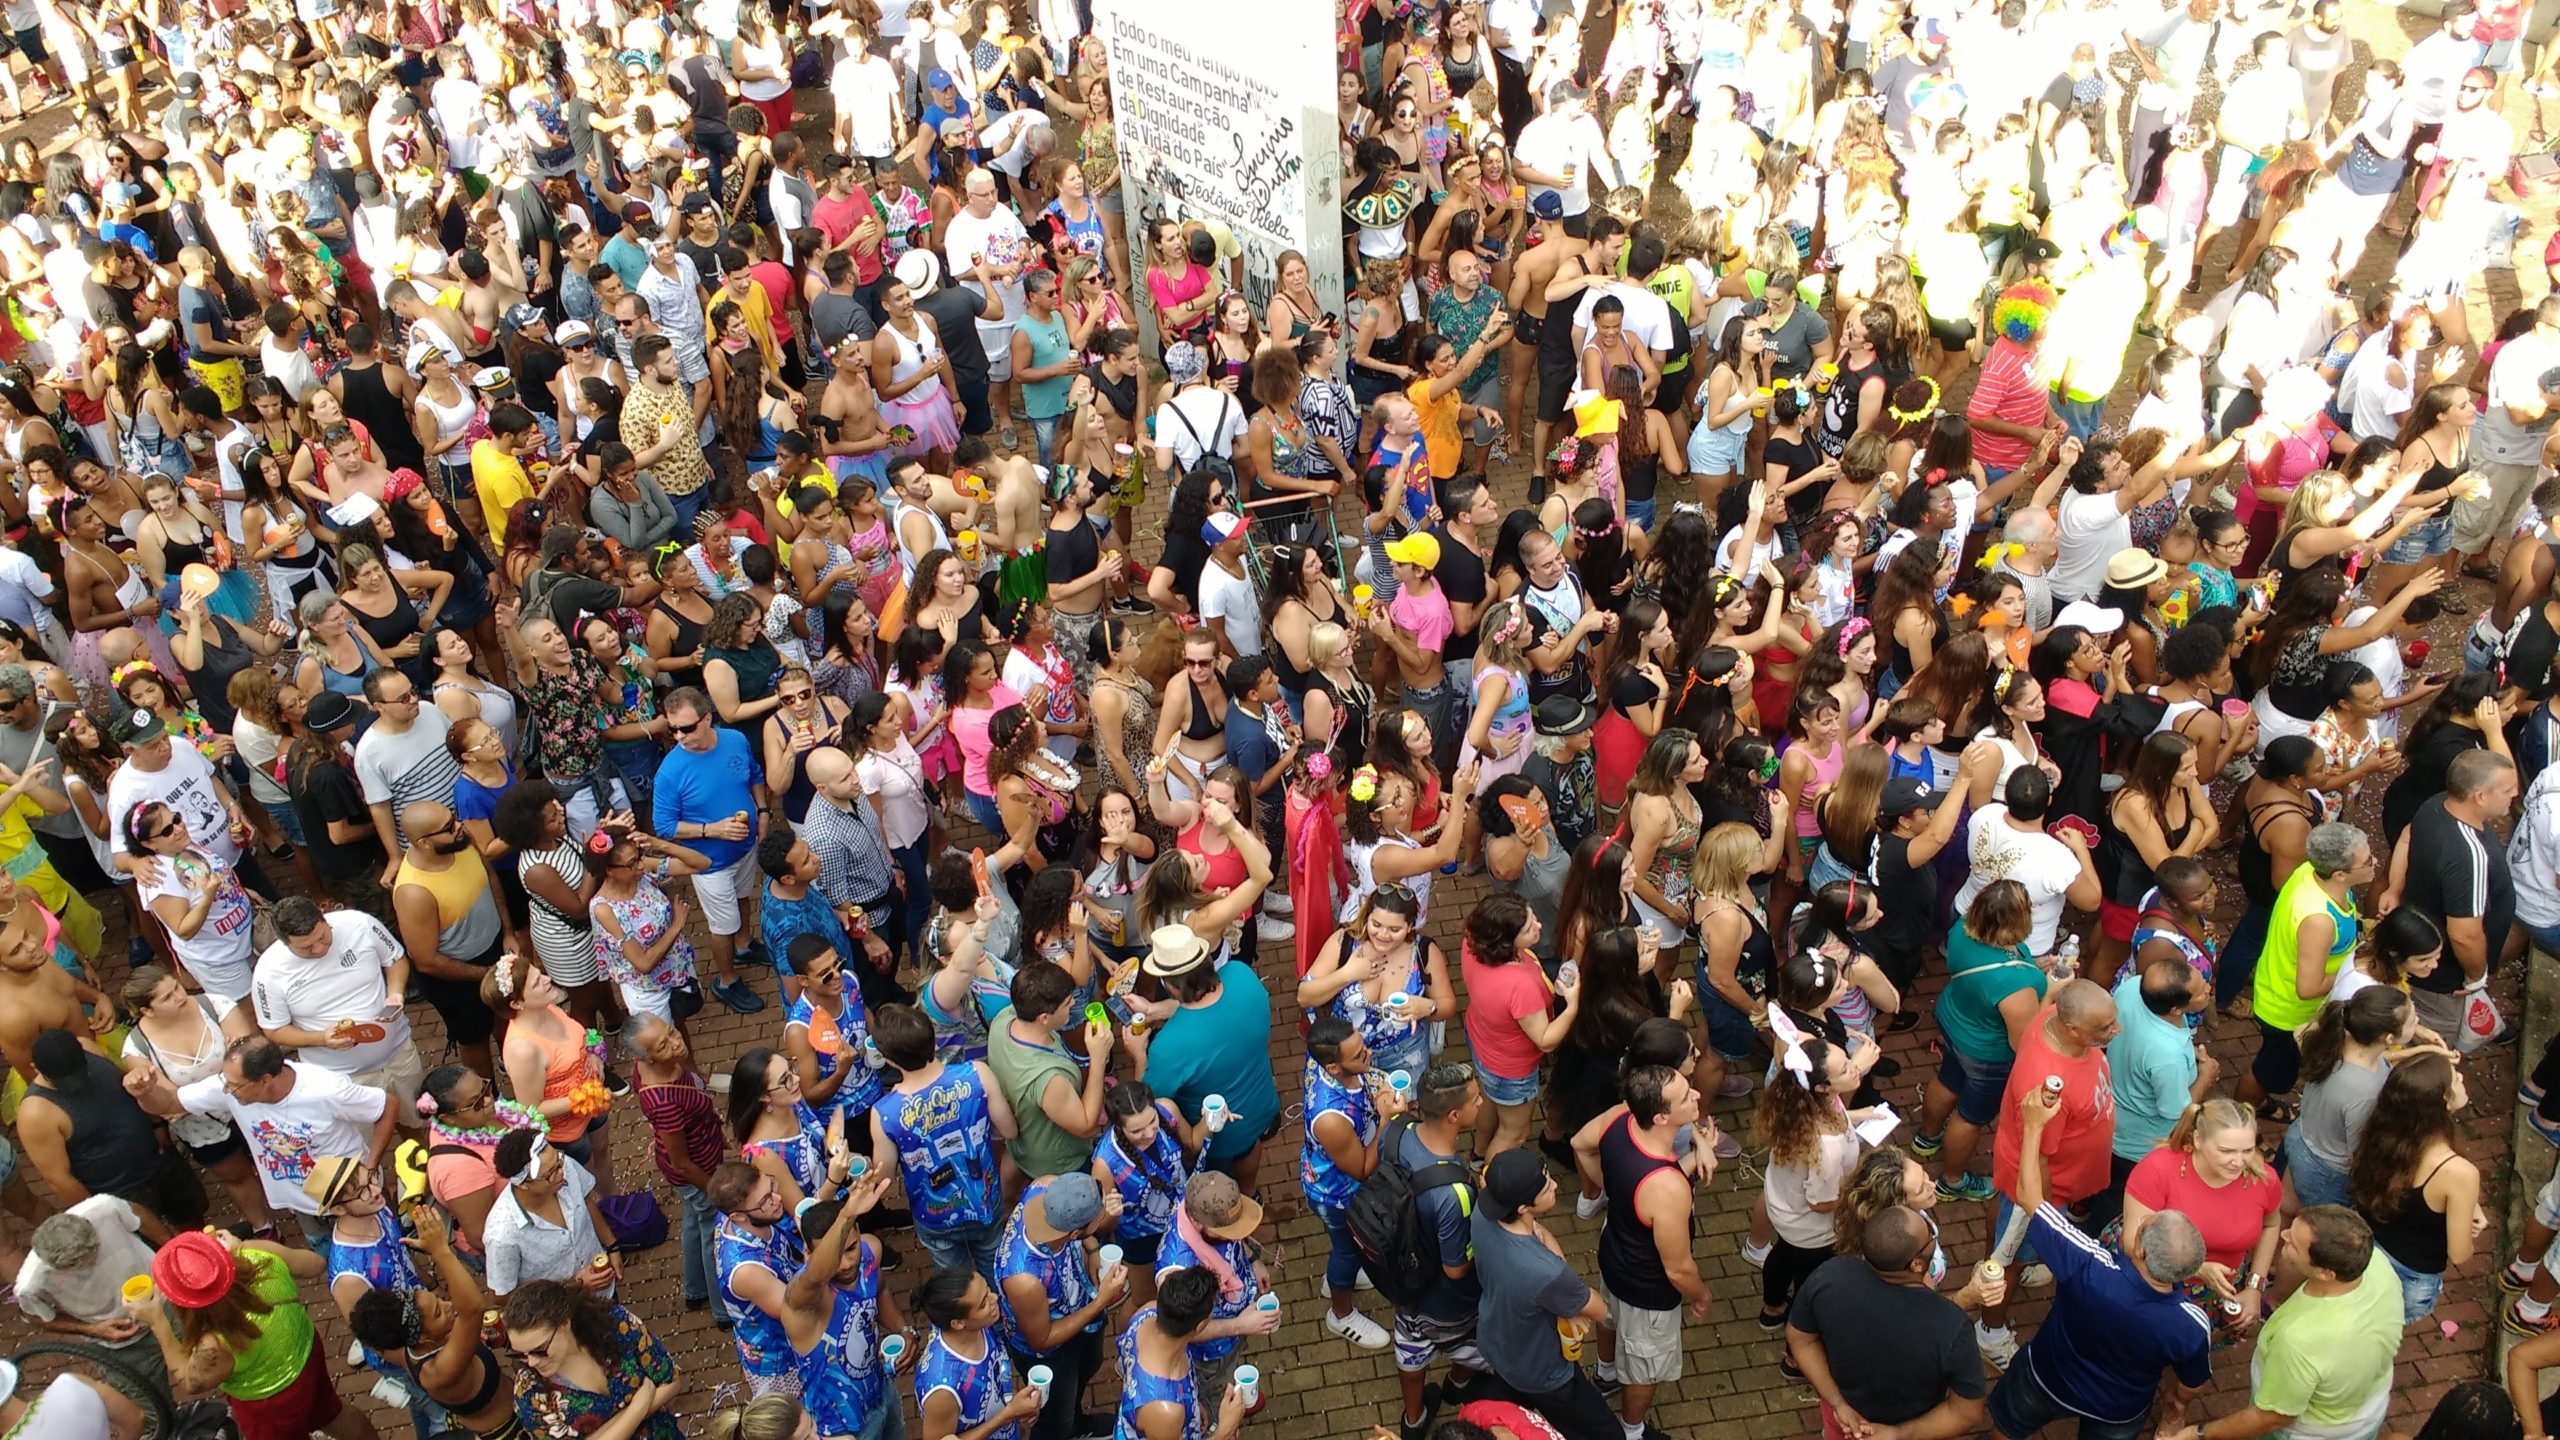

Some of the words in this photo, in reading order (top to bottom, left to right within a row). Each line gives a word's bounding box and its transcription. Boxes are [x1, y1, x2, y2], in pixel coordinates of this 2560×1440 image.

[1110, 11, 1145, 44] Todo
[1148, 32, 1158, 49] o
[1161, 37, 1191, 63] meu
[1112, 37, 1135, 66] Em
[1137, 53, 1168, 80] uma
[1117, 66, 1134, 90] de
[1136, 73, 1231, 131] Restauração
[1119, 92, 1137, 116] da
[1138, 99, 1206, 146] Dignidade
[1122, 118, 1139, 141] da
[1140, 124, 1171, 156] Vida
[1173, 140, 1192, 164] do
[165, 786, 183, 804] QUE
[215, 905, 246, 936] TOMA
[371, 924, 396, 952] NETSHOES
